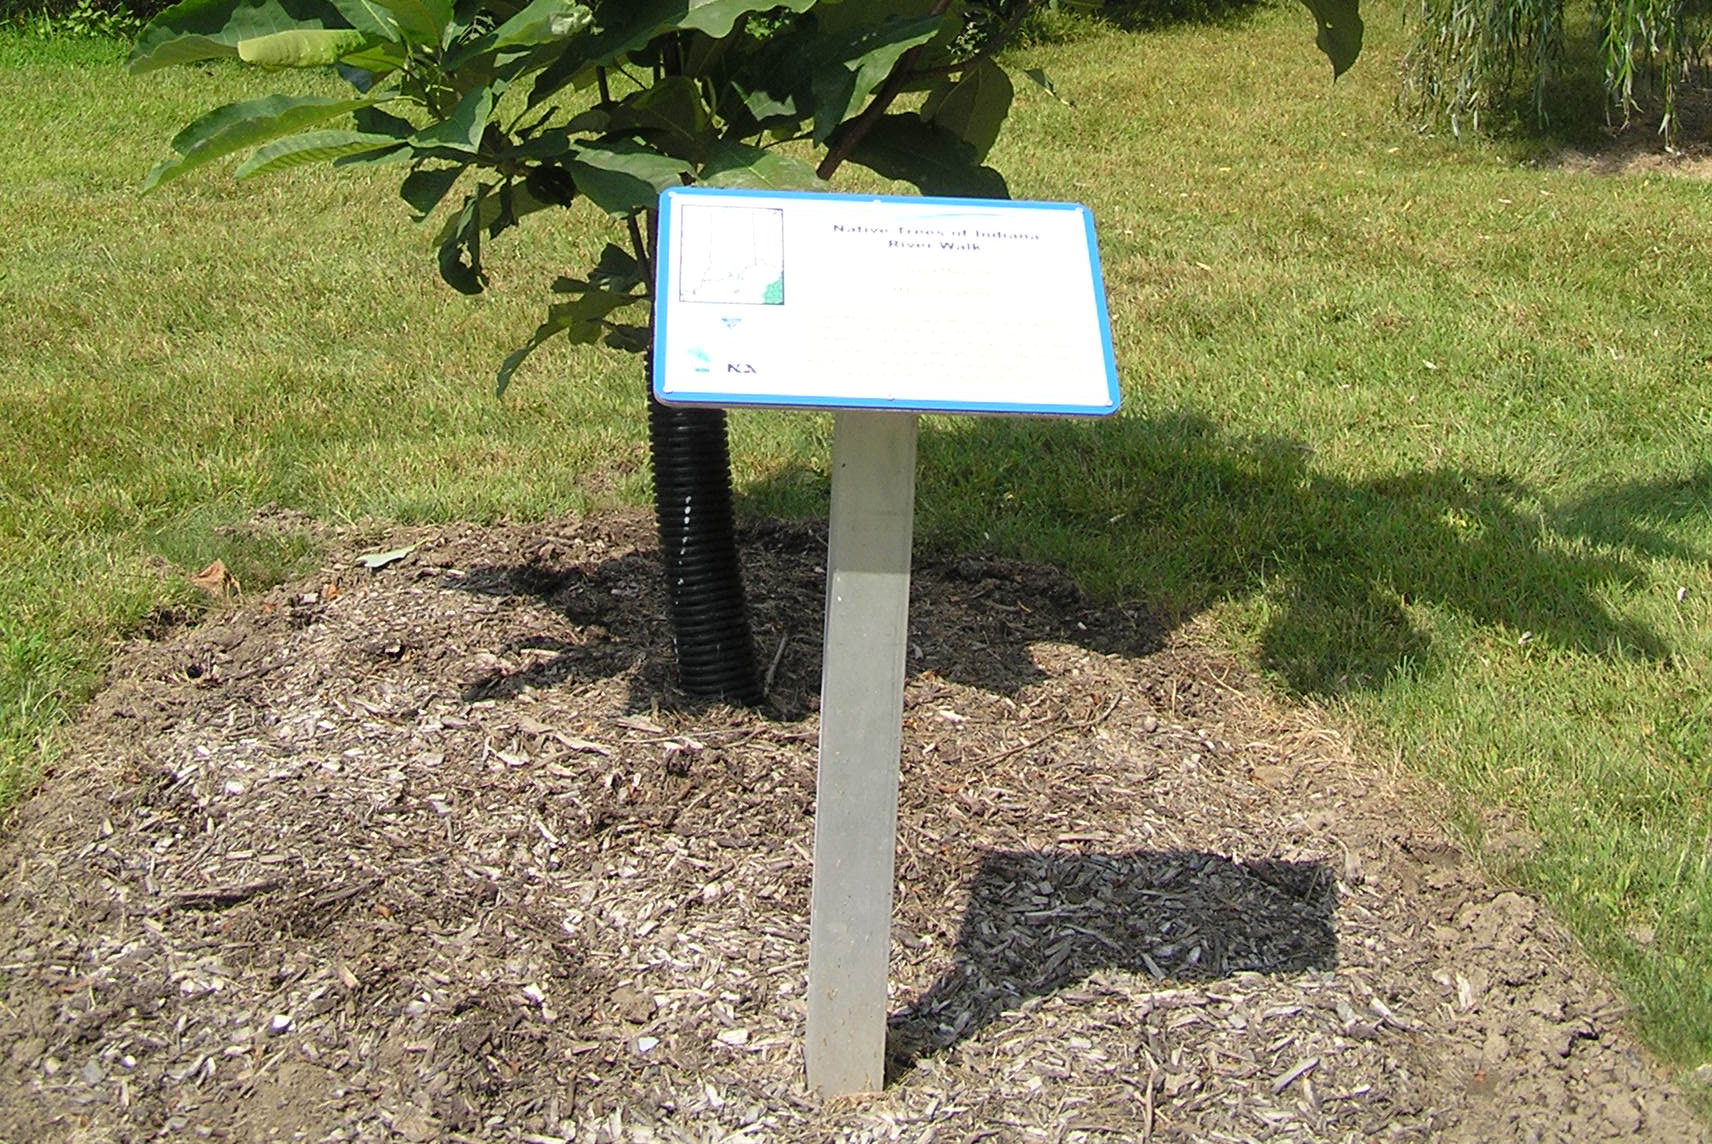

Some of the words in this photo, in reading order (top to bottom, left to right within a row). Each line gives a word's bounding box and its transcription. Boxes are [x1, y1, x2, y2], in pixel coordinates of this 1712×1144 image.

[833, 224, 888, 233] Native
[898, 226, 944, 237] Trees
[952, 228, 967, 237] of
[976, 229, 1039, 240] Indiana
[888, 239, 932, 249] River
[940, 241, 980, 251] Walk
